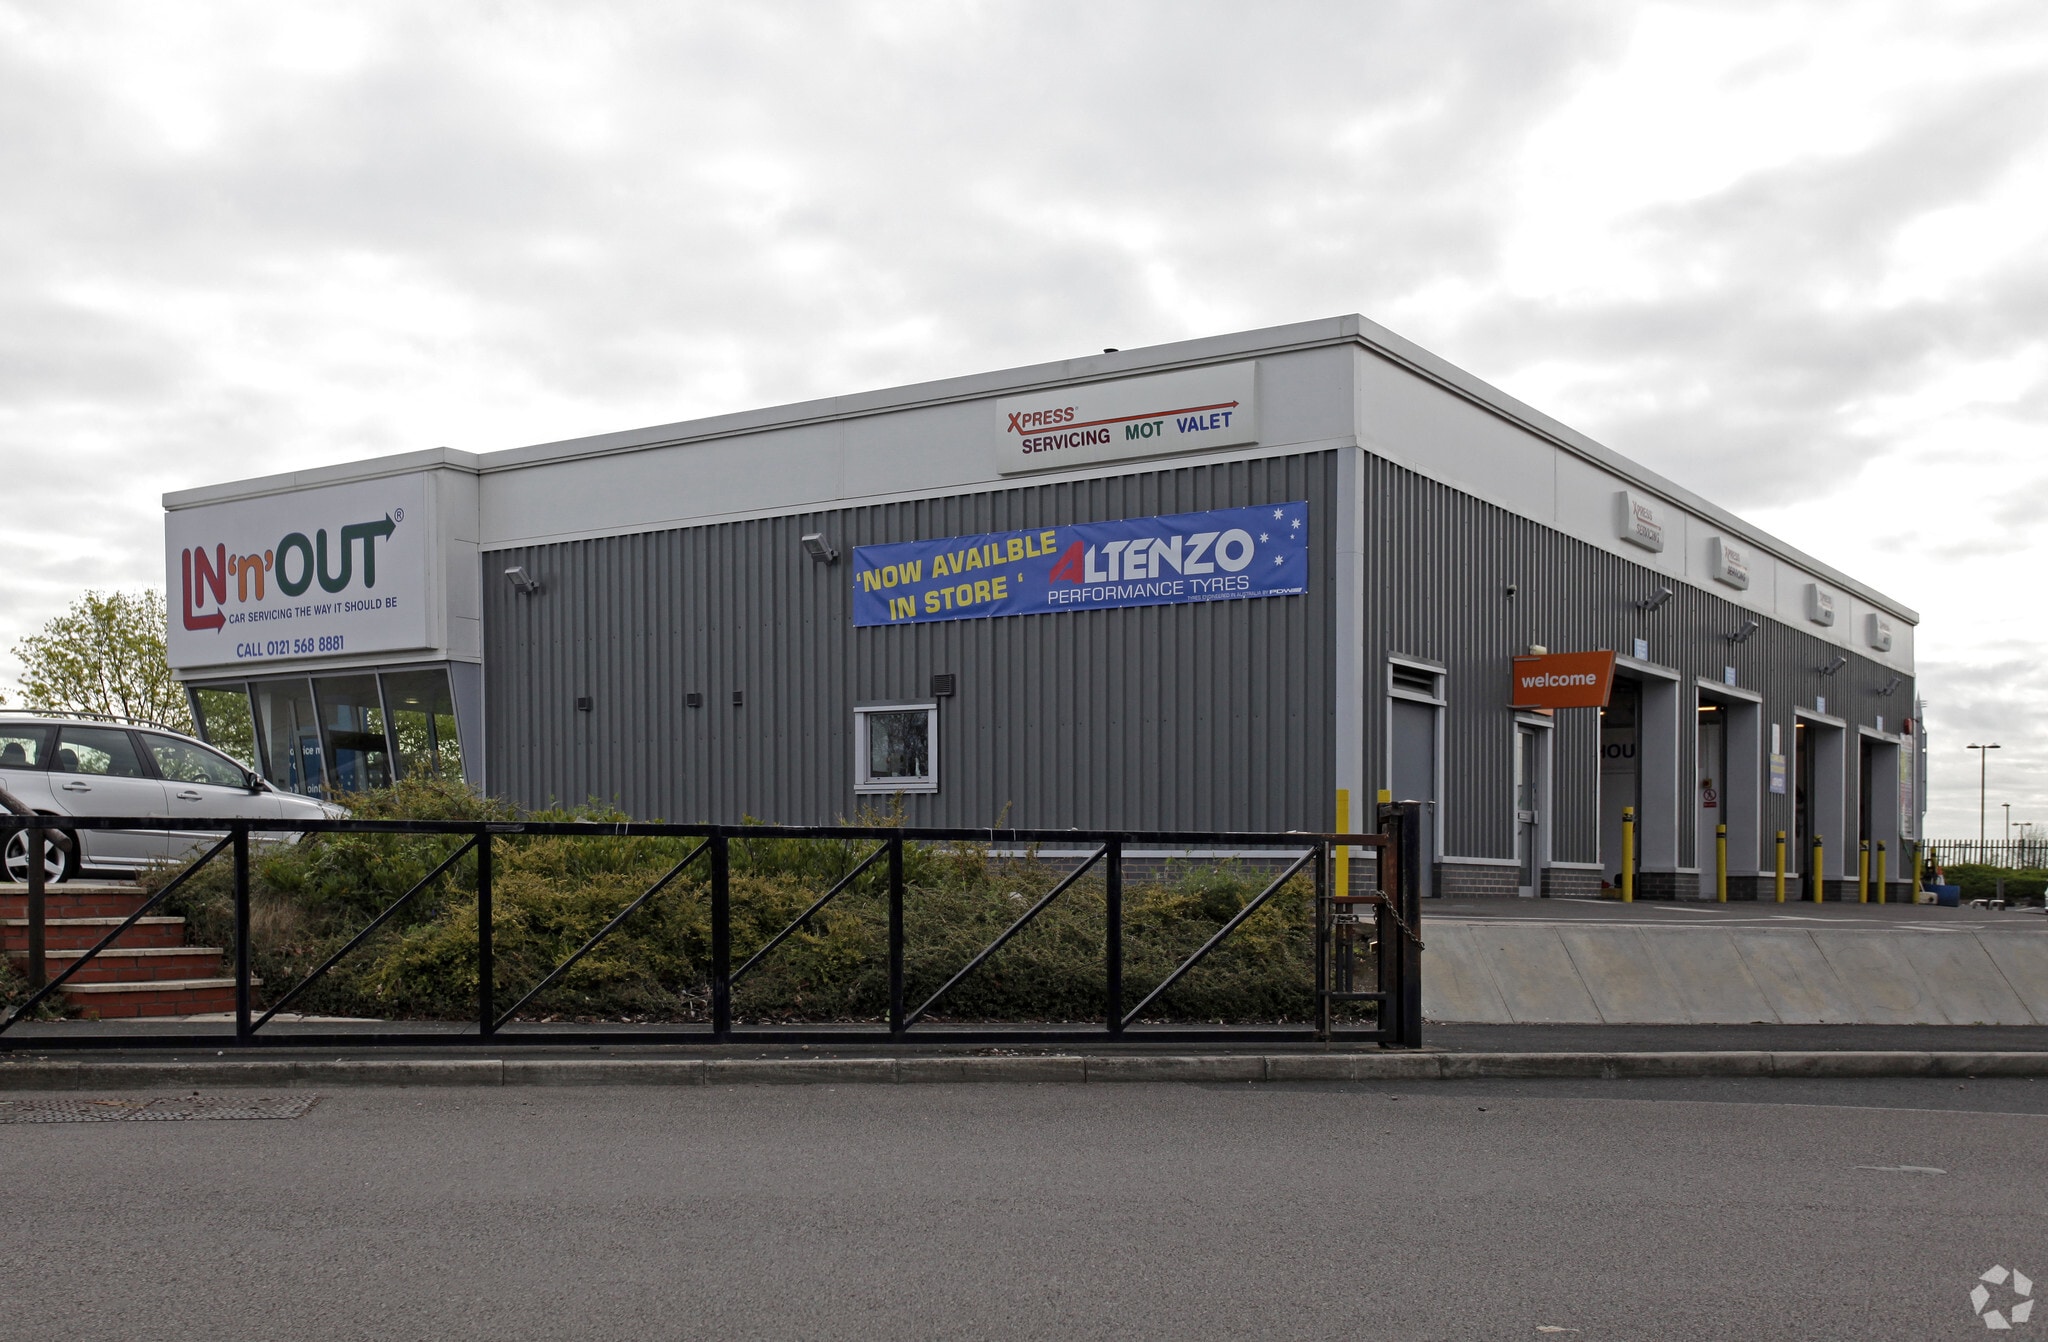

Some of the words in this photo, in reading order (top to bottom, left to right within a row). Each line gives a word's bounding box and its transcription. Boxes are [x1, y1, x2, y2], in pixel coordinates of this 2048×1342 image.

[1007, 407, 1075, 433] XPRESS
[1022, 428, 1110, 454] SERVICING
[1125, 420, 1164, 441] MOT
[1176, 411, 1233, 434] VALET
[932, 530, 1057, 579] AVAILBLE
[1049, 528, 1255, 585] ALTENZO
[889, 595, 916, 621] IN
[924, 576, 1008, 614] STORE
[1048, 580, 1184, 605] PERFORMANCE
[1190, 575, 1250, 594] TYRES
[229, 613, 246, 624] CAR
[248, 608, 292, 622] SERVICING
[295, 606, 311, 617] THE
[314, 604, 332, 615] WAY
[334, 602, 342, 614] IT
[344, 598, 382, 612] SHOULD
[385, 597, 398, 608] BE
[236, 642, 263, 658] CALL
[267, 640, 290, 656] 0121
[293, 637, 315, 654] 568
[318, 635, 344, 652] 8881
[1521, 672, 1597, 688] welcome
